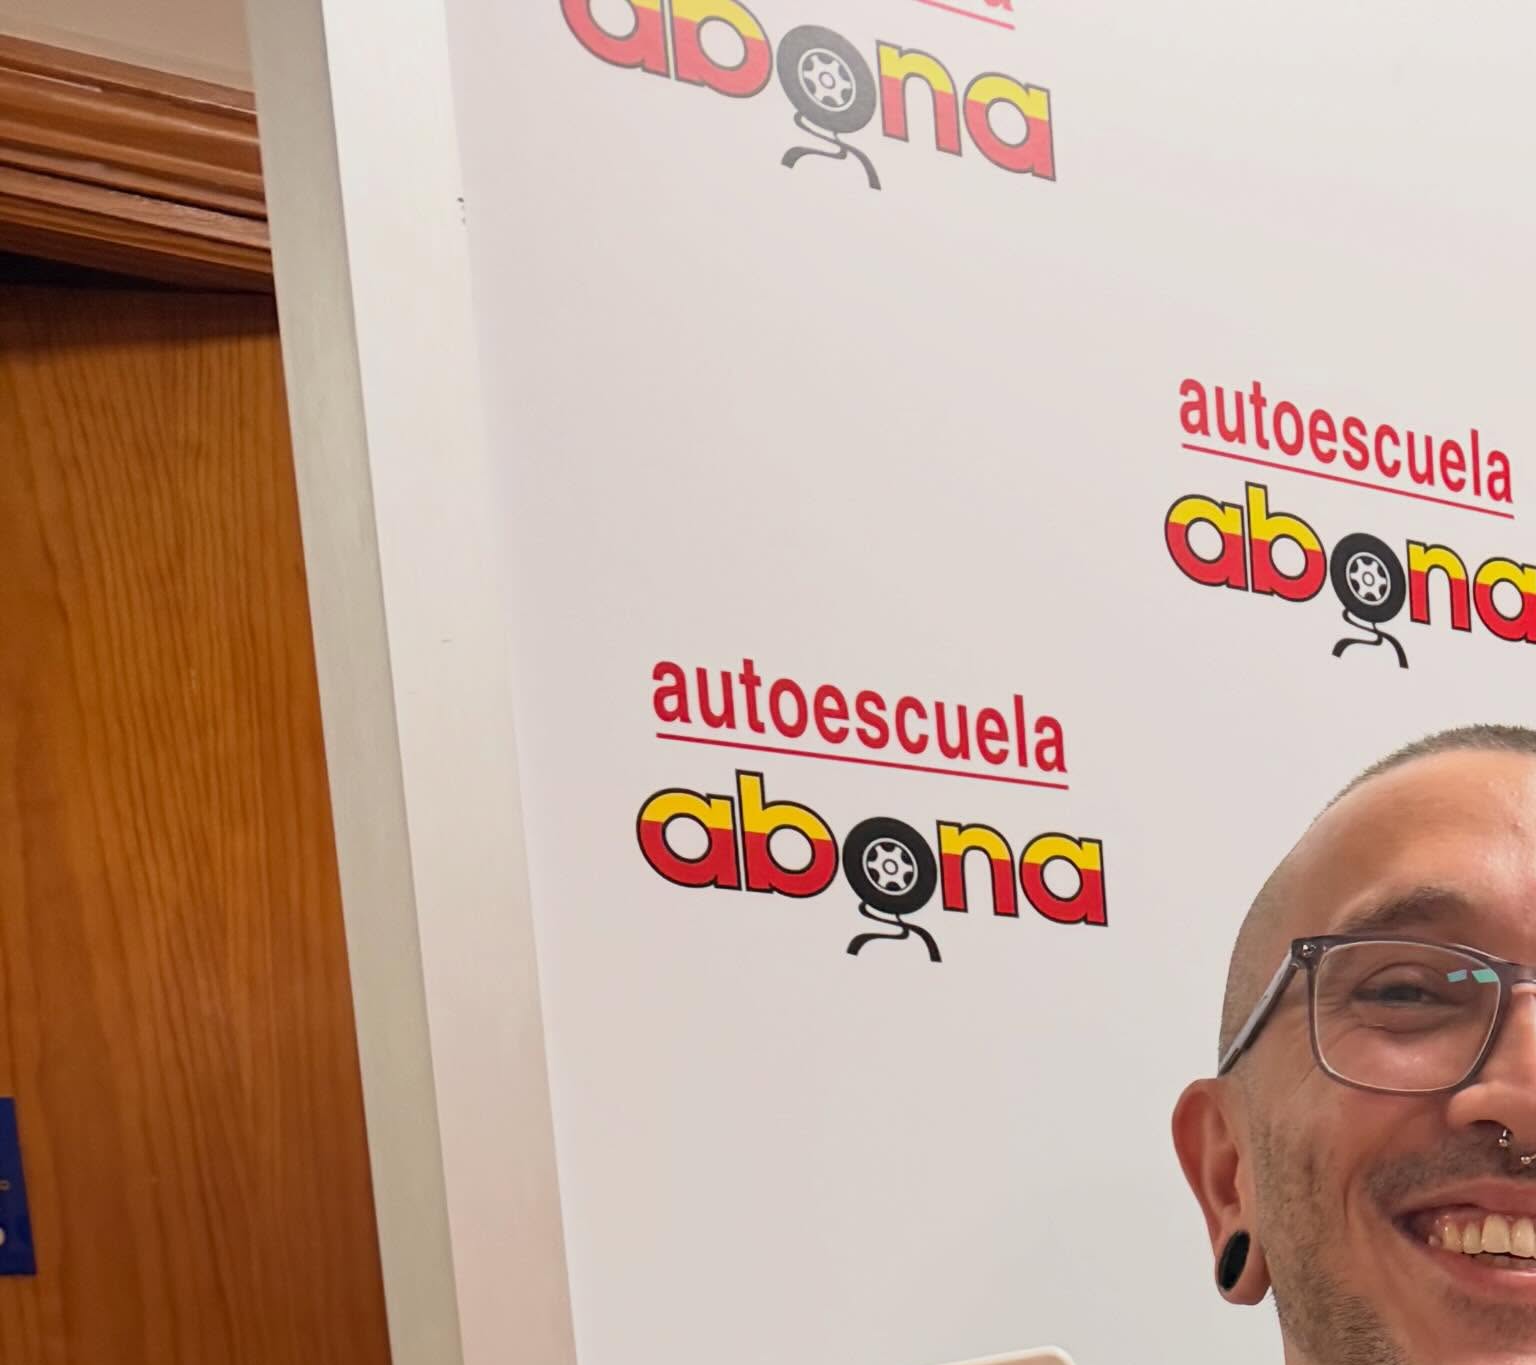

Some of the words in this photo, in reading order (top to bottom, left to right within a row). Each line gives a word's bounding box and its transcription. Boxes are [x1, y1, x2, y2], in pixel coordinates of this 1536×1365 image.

[1178, 377, 1514, 504] autoescuela
[651, 657, 1068, 774] autoescuela
[636, 769, 1107, 927] abona
